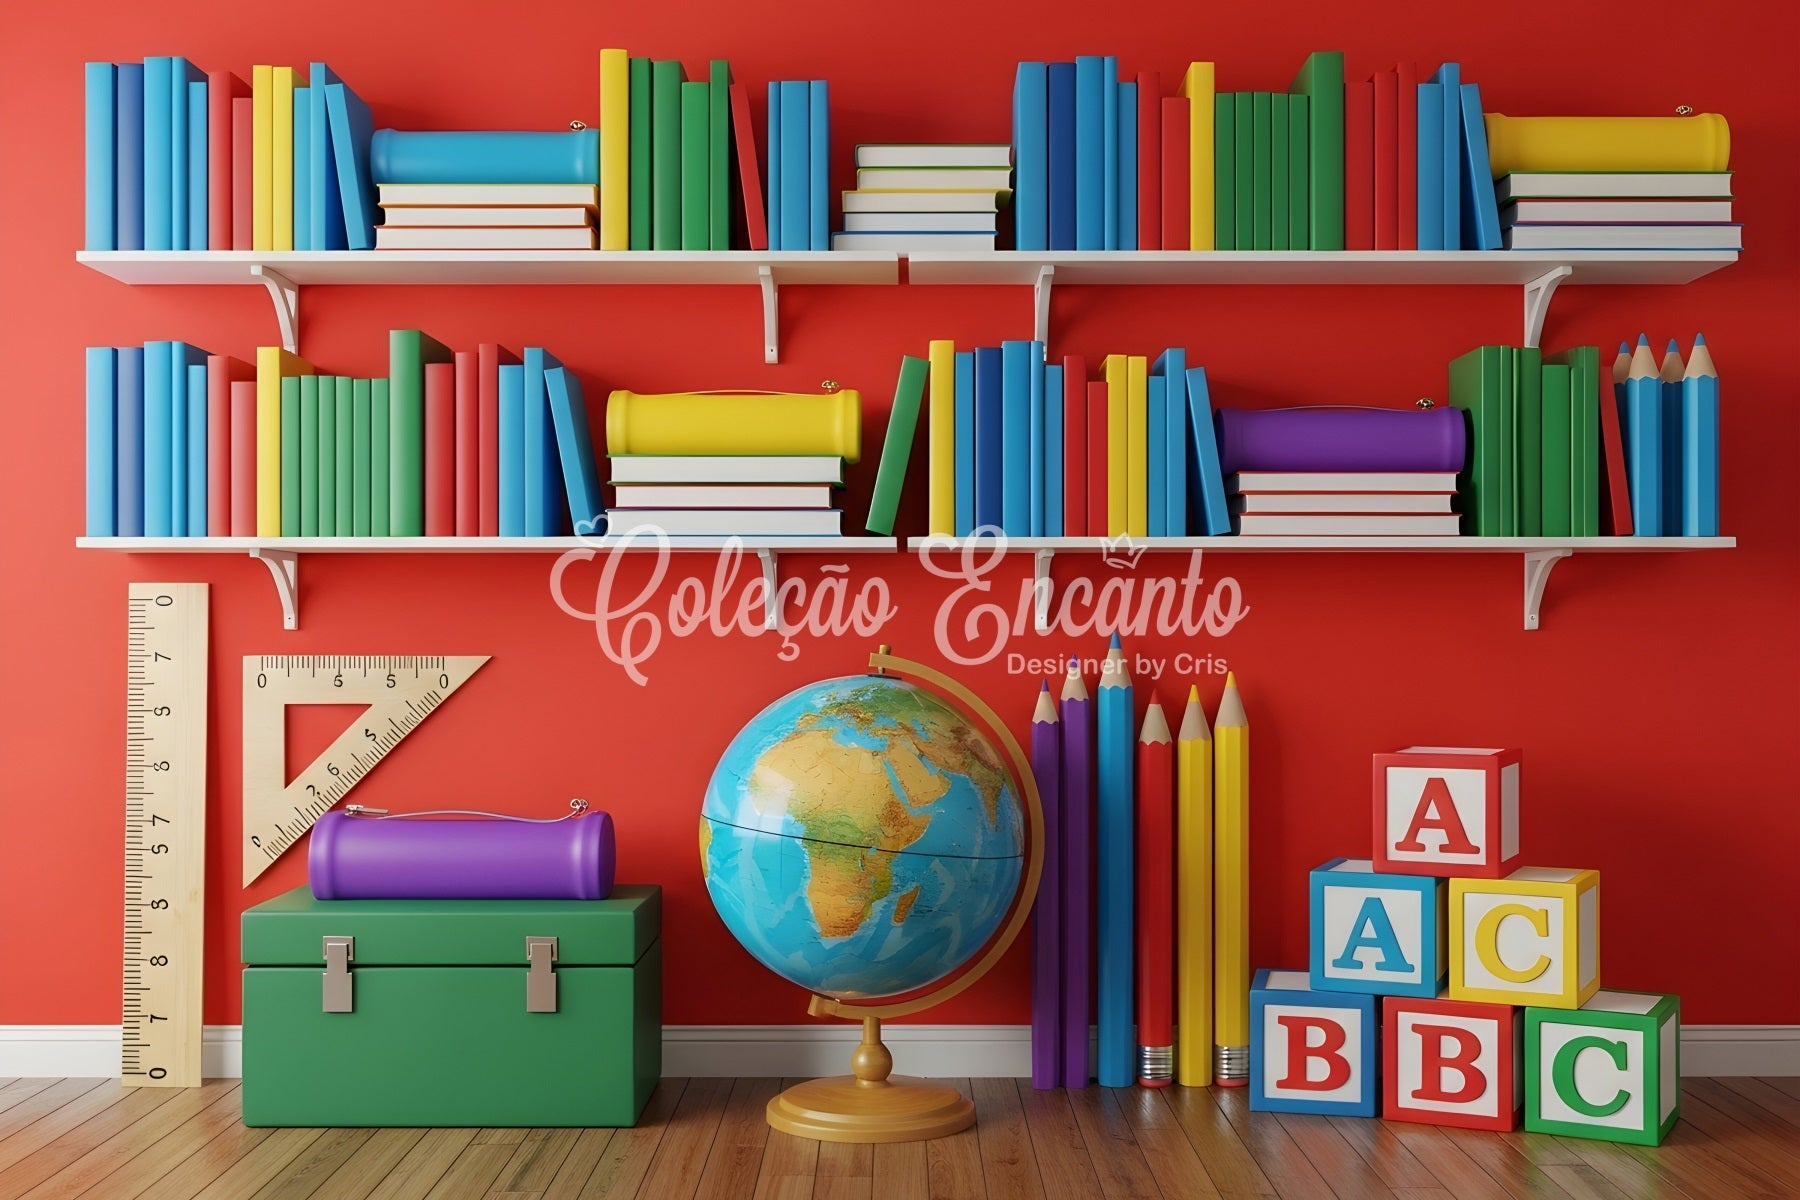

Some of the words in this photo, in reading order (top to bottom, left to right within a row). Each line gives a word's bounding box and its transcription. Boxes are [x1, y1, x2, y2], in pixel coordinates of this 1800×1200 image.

[154, 594, 173, 607] 0
[257, 673, 267, 689] 0
[386, 673, 397, 689] 5
[438, 673, 449, 690] 0
[326, 762, 340, 777] 6
[1394, 777, 1480, 855] A
[149, 954, 169, 967] 8
[1332, 897, 1415, 973] A
[1475, 903, 1552, 984] C
[148, 1067, 167, 1080] 0
[1276, 1015, 1351, 1092] B
[1411, 1023, 1487, 1104] B
[1552, 1035, 1631, 1118] C
